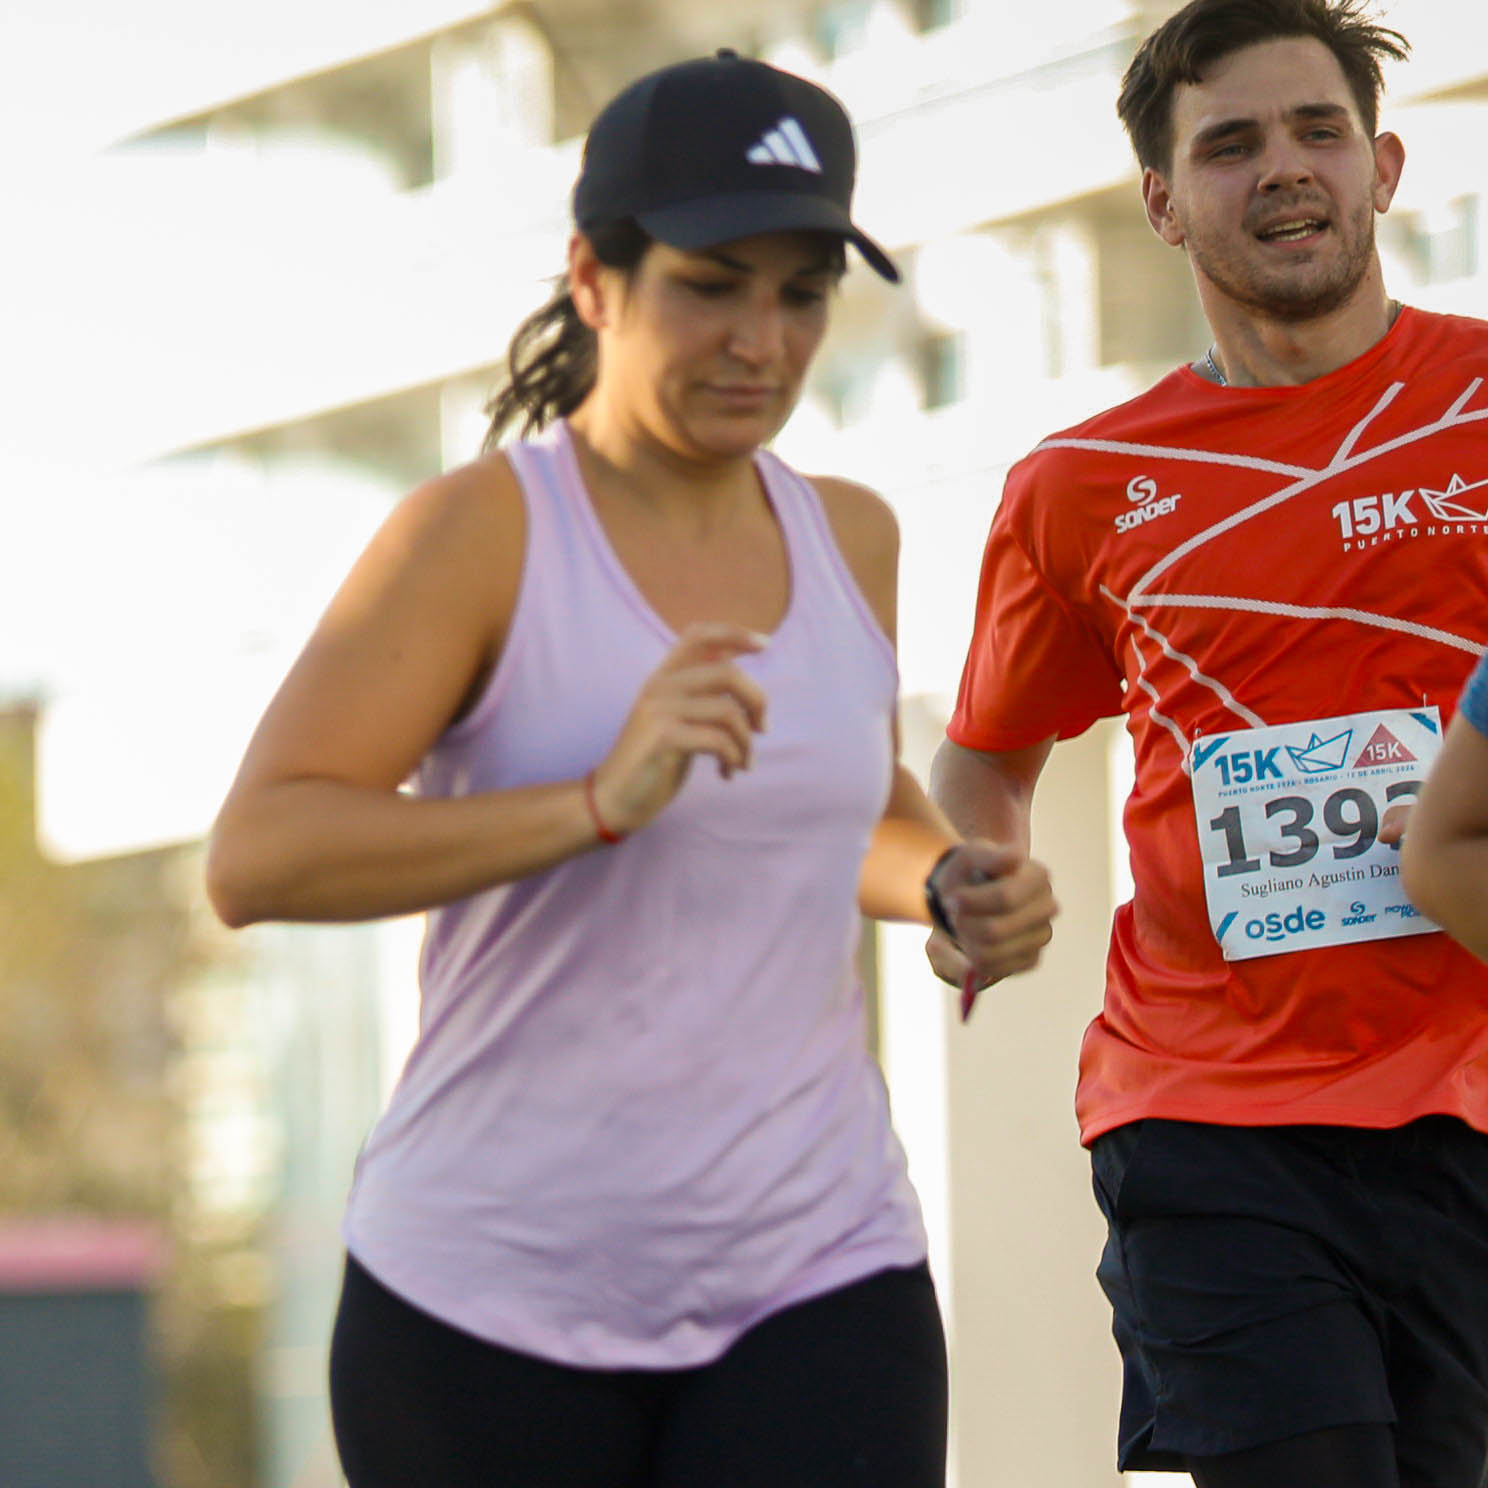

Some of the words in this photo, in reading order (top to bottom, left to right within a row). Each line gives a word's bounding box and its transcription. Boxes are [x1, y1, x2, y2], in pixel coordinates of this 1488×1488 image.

[1331, 489, 1419, 539] 15K
[1343, 527, 1419, 552] PUERTO
[1214, 746, 1284, 786] 15K
[1366, 742, 1402, 761] 15K
[1241, 879, 1303, 898] Sugliano
[1308, 866, 1365, 888] Agustin
[1370, 864, 1401, 880] Dan
